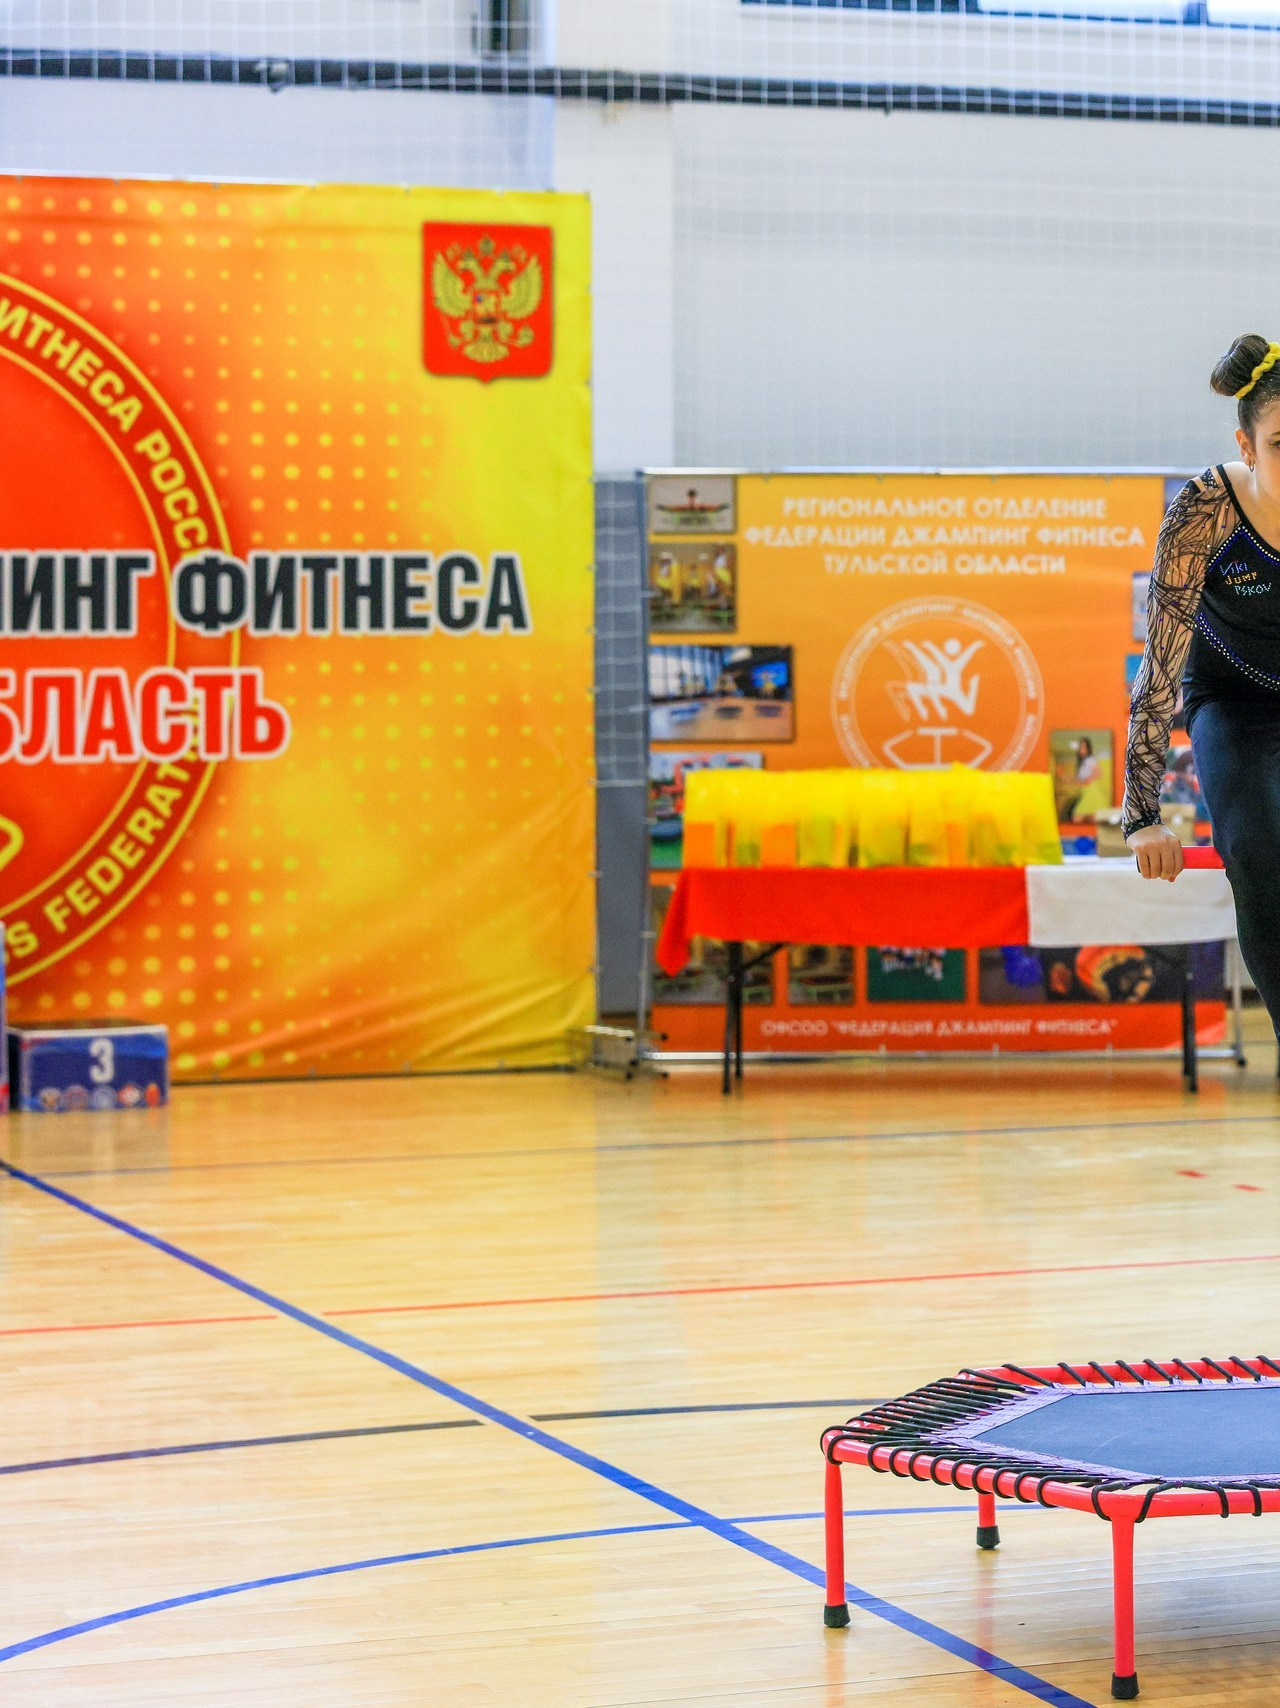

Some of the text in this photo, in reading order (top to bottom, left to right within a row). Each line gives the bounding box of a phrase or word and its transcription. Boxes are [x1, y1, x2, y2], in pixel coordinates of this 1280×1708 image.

[134, 428, 212, 557] РОСС
[782, 495, 1107, 520] РЕГИОНАЛЬНОЕ ОТДЕЛЕНИЕ
[744, 525, 1146, 550] ФЕДЕРАЦИИ ДЖАМПИНГ ФИТНЕСА
[823, 549, 1066, 576] ТУЛЬСКОЙ ОБЛАСТИ
[0, 550, 531, 636] ИНГ ФИТНЕСА
[43, 690, 200, 934] FEDERAT
[760, 1019, 828, 1037] ОФСОО
[937, 1018, 1031, 1037] ДЖАМПИНГ
[89, 1038, 115, 1083] 3
